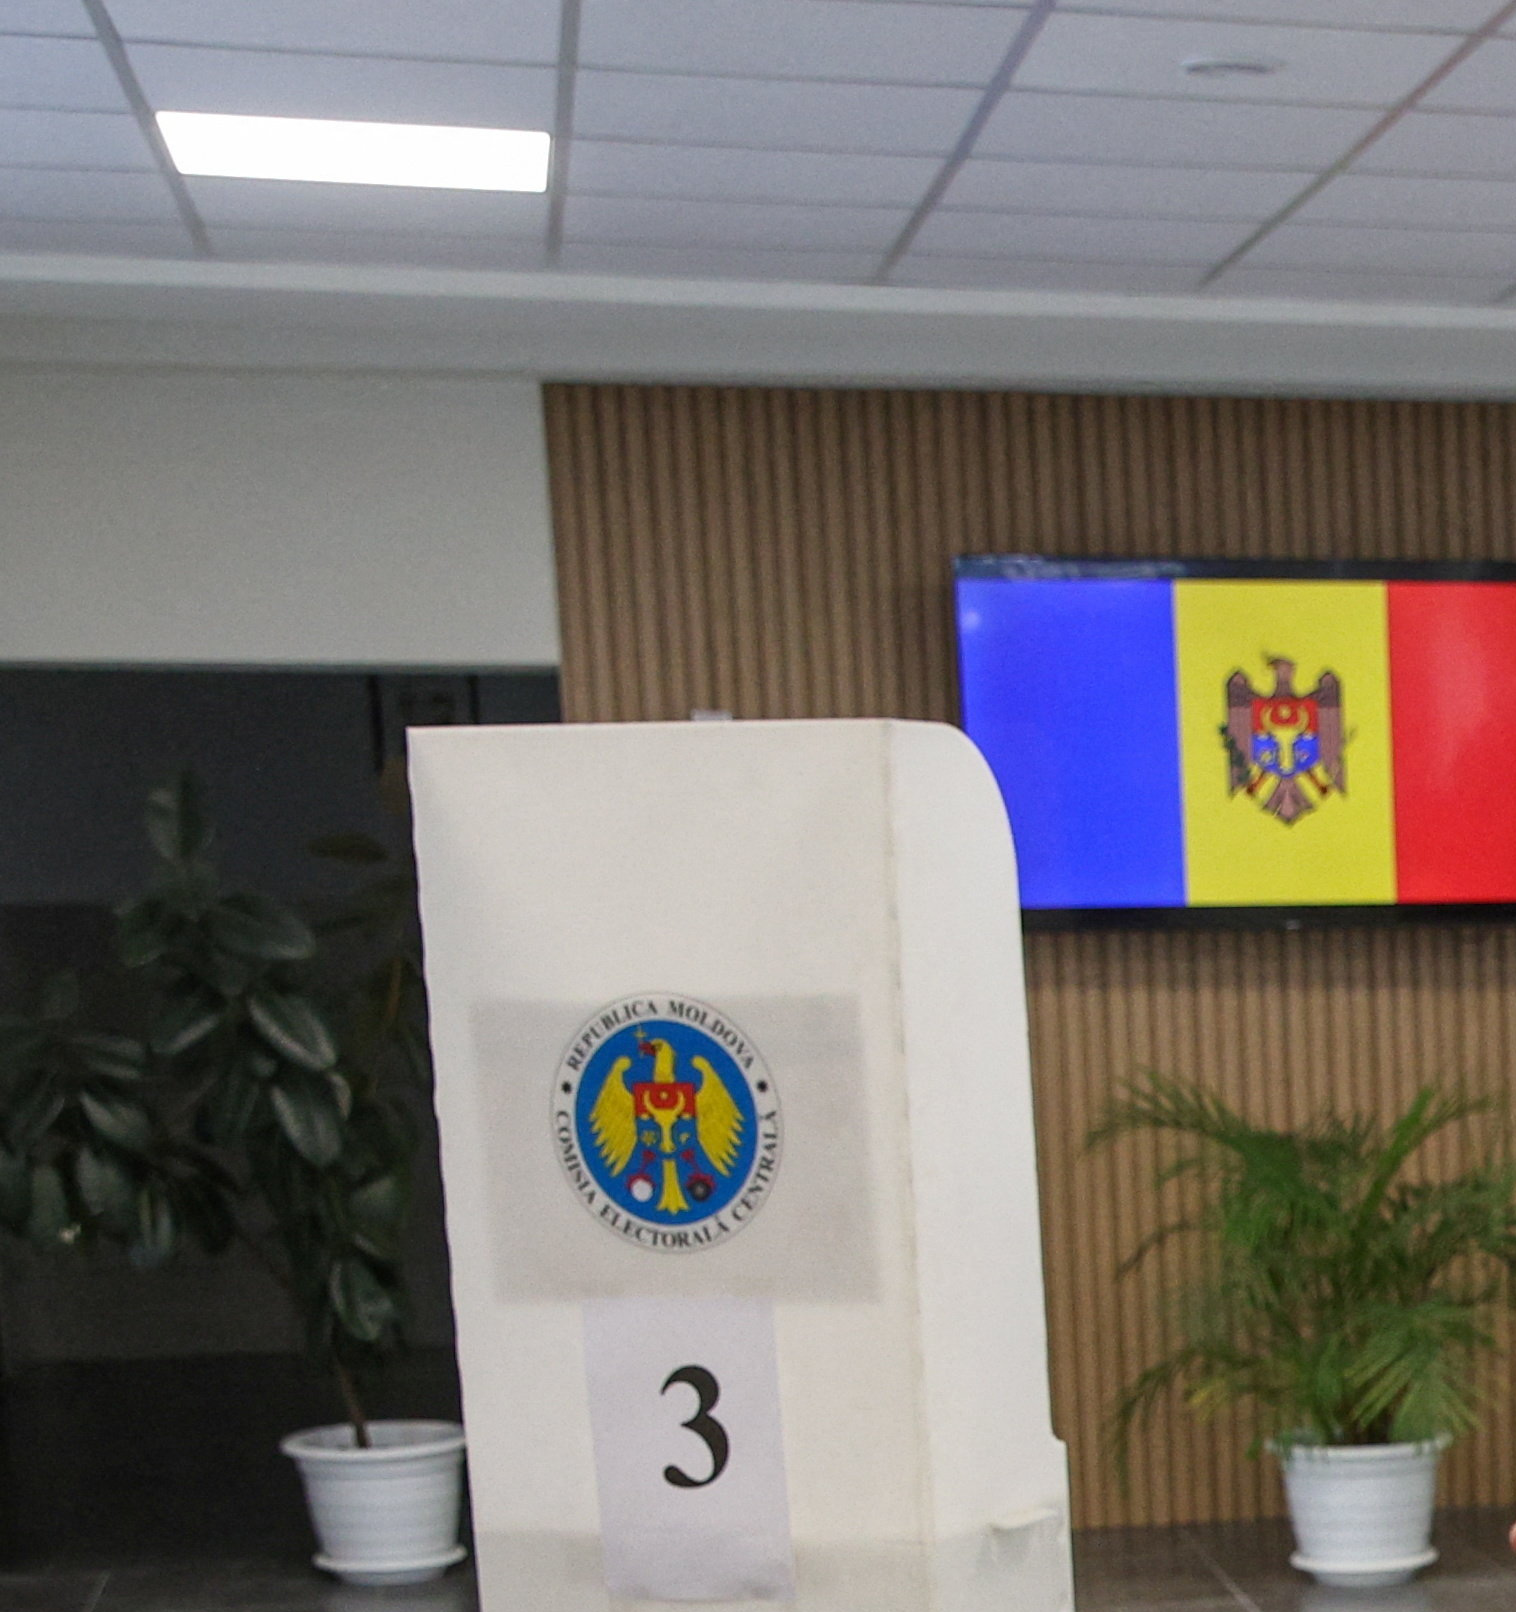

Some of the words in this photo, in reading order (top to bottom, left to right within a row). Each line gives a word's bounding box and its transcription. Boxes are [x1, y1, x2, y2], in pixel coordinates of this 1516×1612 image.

[567, 1000, 658, 1072] REPUBLICA
[668, 1000, 754, 1070] MOLDOVA
[557, 1110, 597, 1205] COMISIA
[660, 1364, 730, 1489] 3
